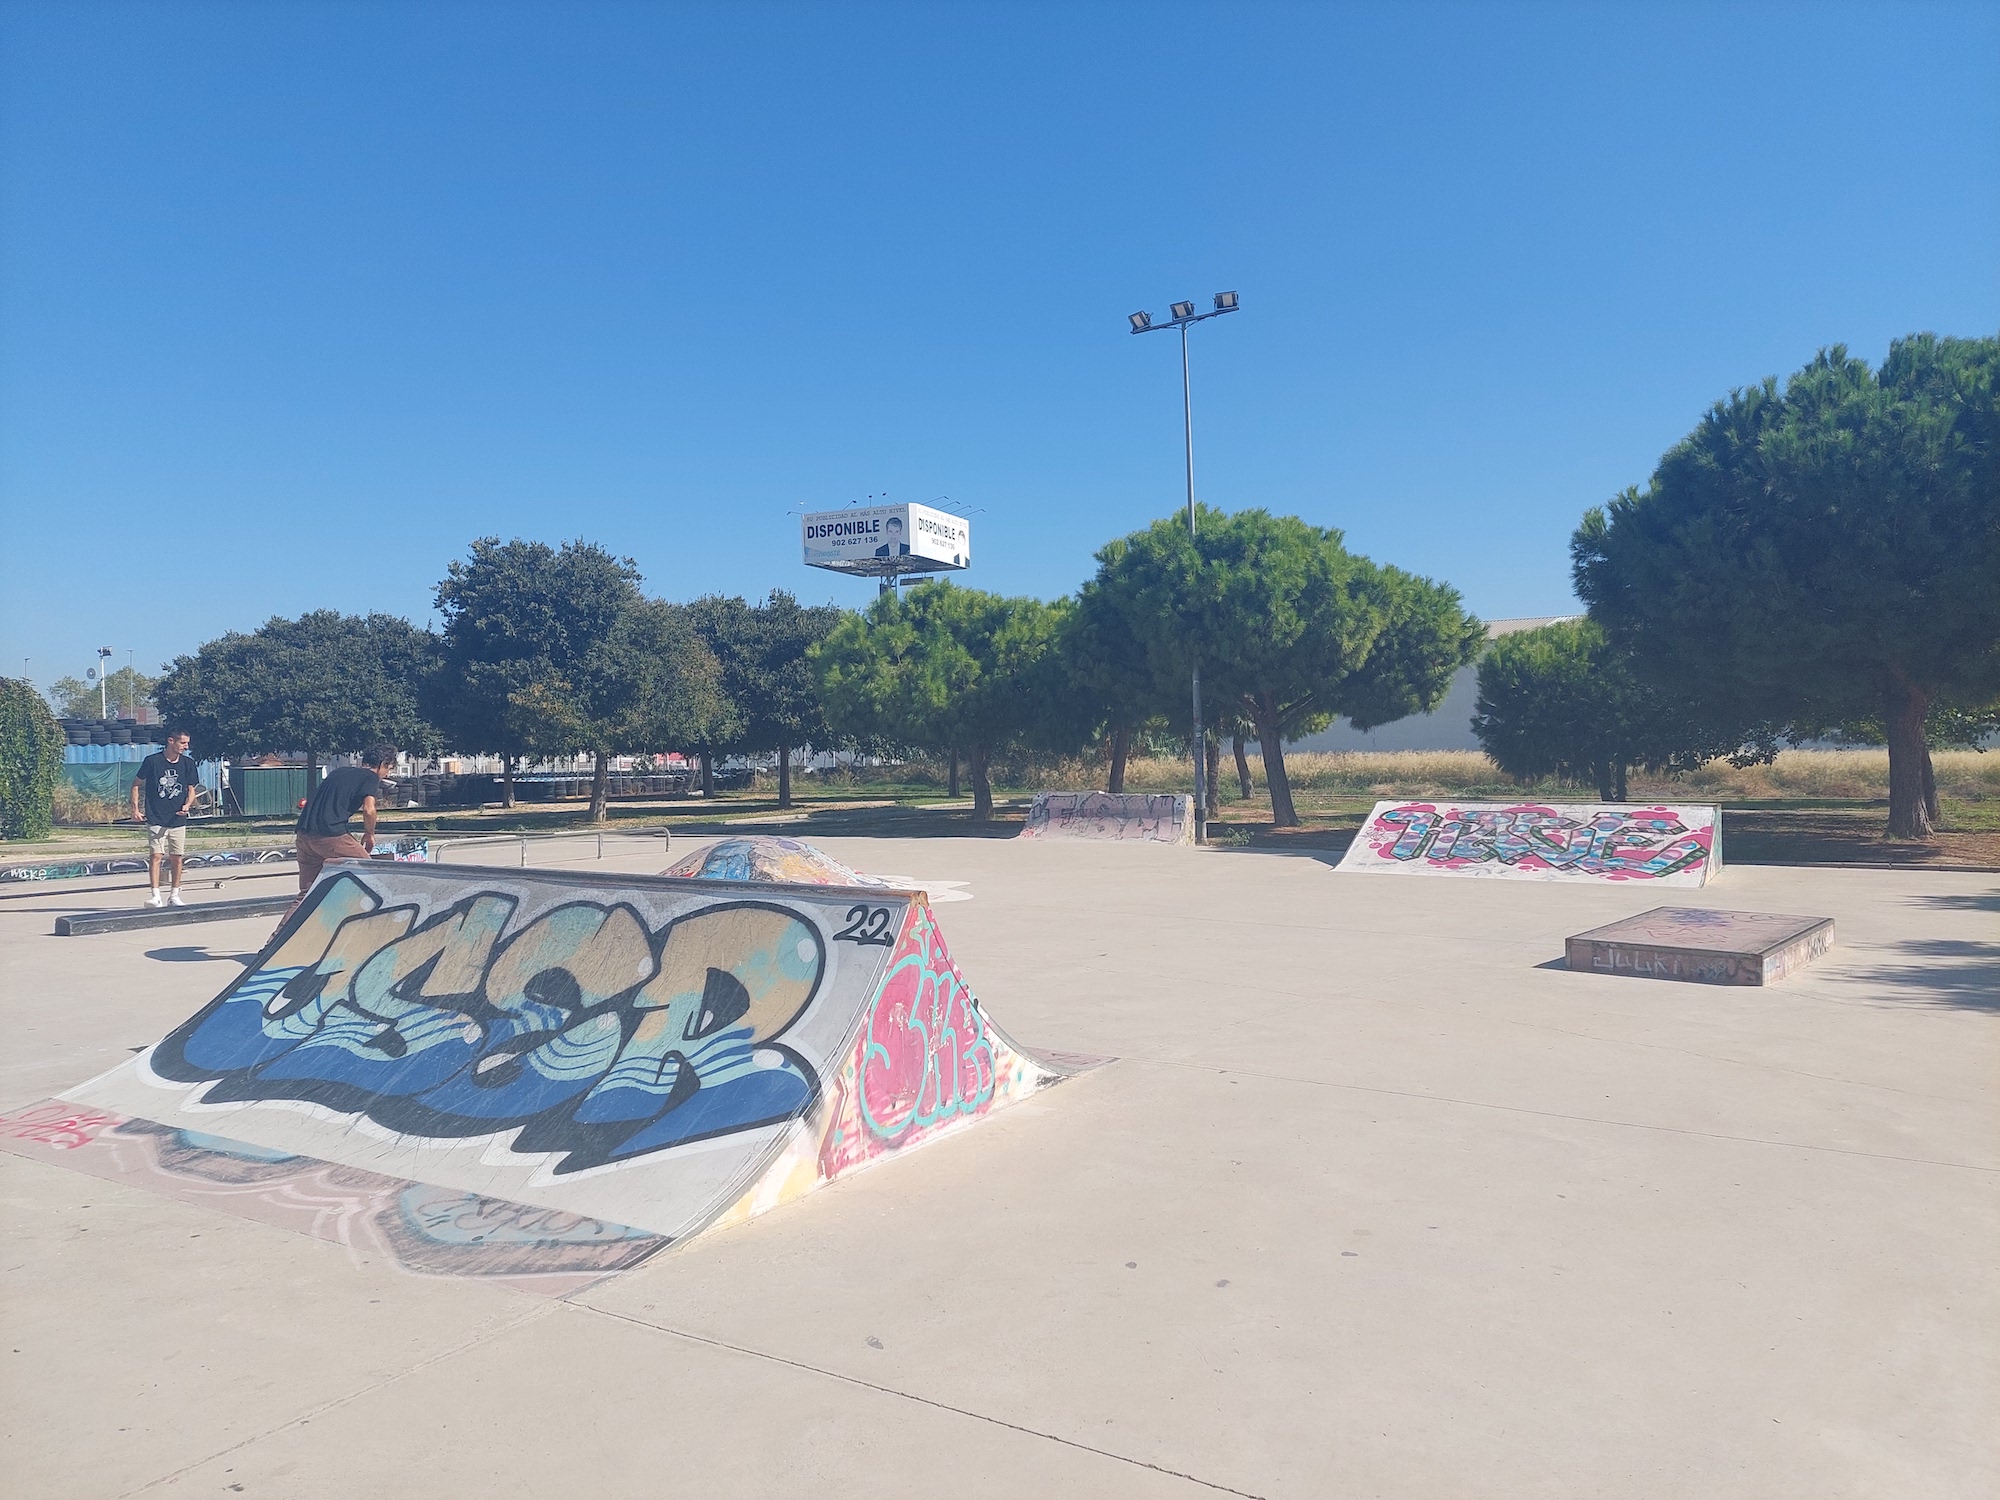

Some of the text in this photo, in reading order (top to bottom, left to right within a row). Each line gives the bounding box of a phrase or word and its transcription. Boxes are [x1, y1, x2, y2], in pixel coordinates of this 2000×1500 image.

[807, 519, 880, 539] DISPONIBLE
[918, 517, 956, 541] DISPONIBLE
[831, 536, 879, 546] 902 627 136
[833, 904, 894, 947] 22
